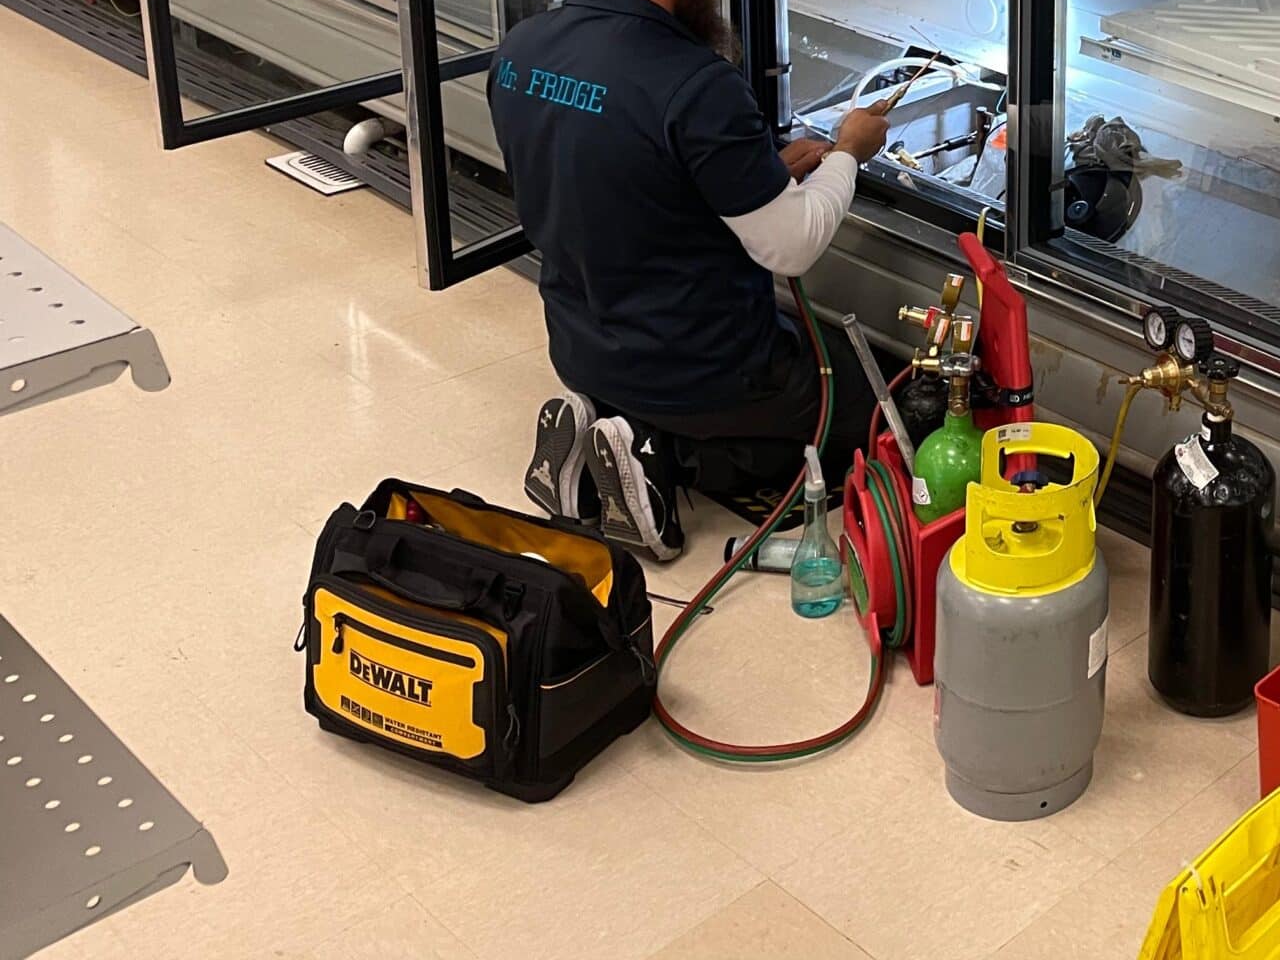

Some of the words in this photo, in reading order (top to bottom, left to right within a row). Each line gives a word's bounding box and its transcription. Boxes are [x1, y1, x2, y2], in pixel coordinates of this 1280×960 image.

[496, 57, 517, 92] Mr.
[525, 69, 608, 113] FRIDGE
[384, 717, 406, 730] WATER
[406, 723, 443, 740] RESISTANT
